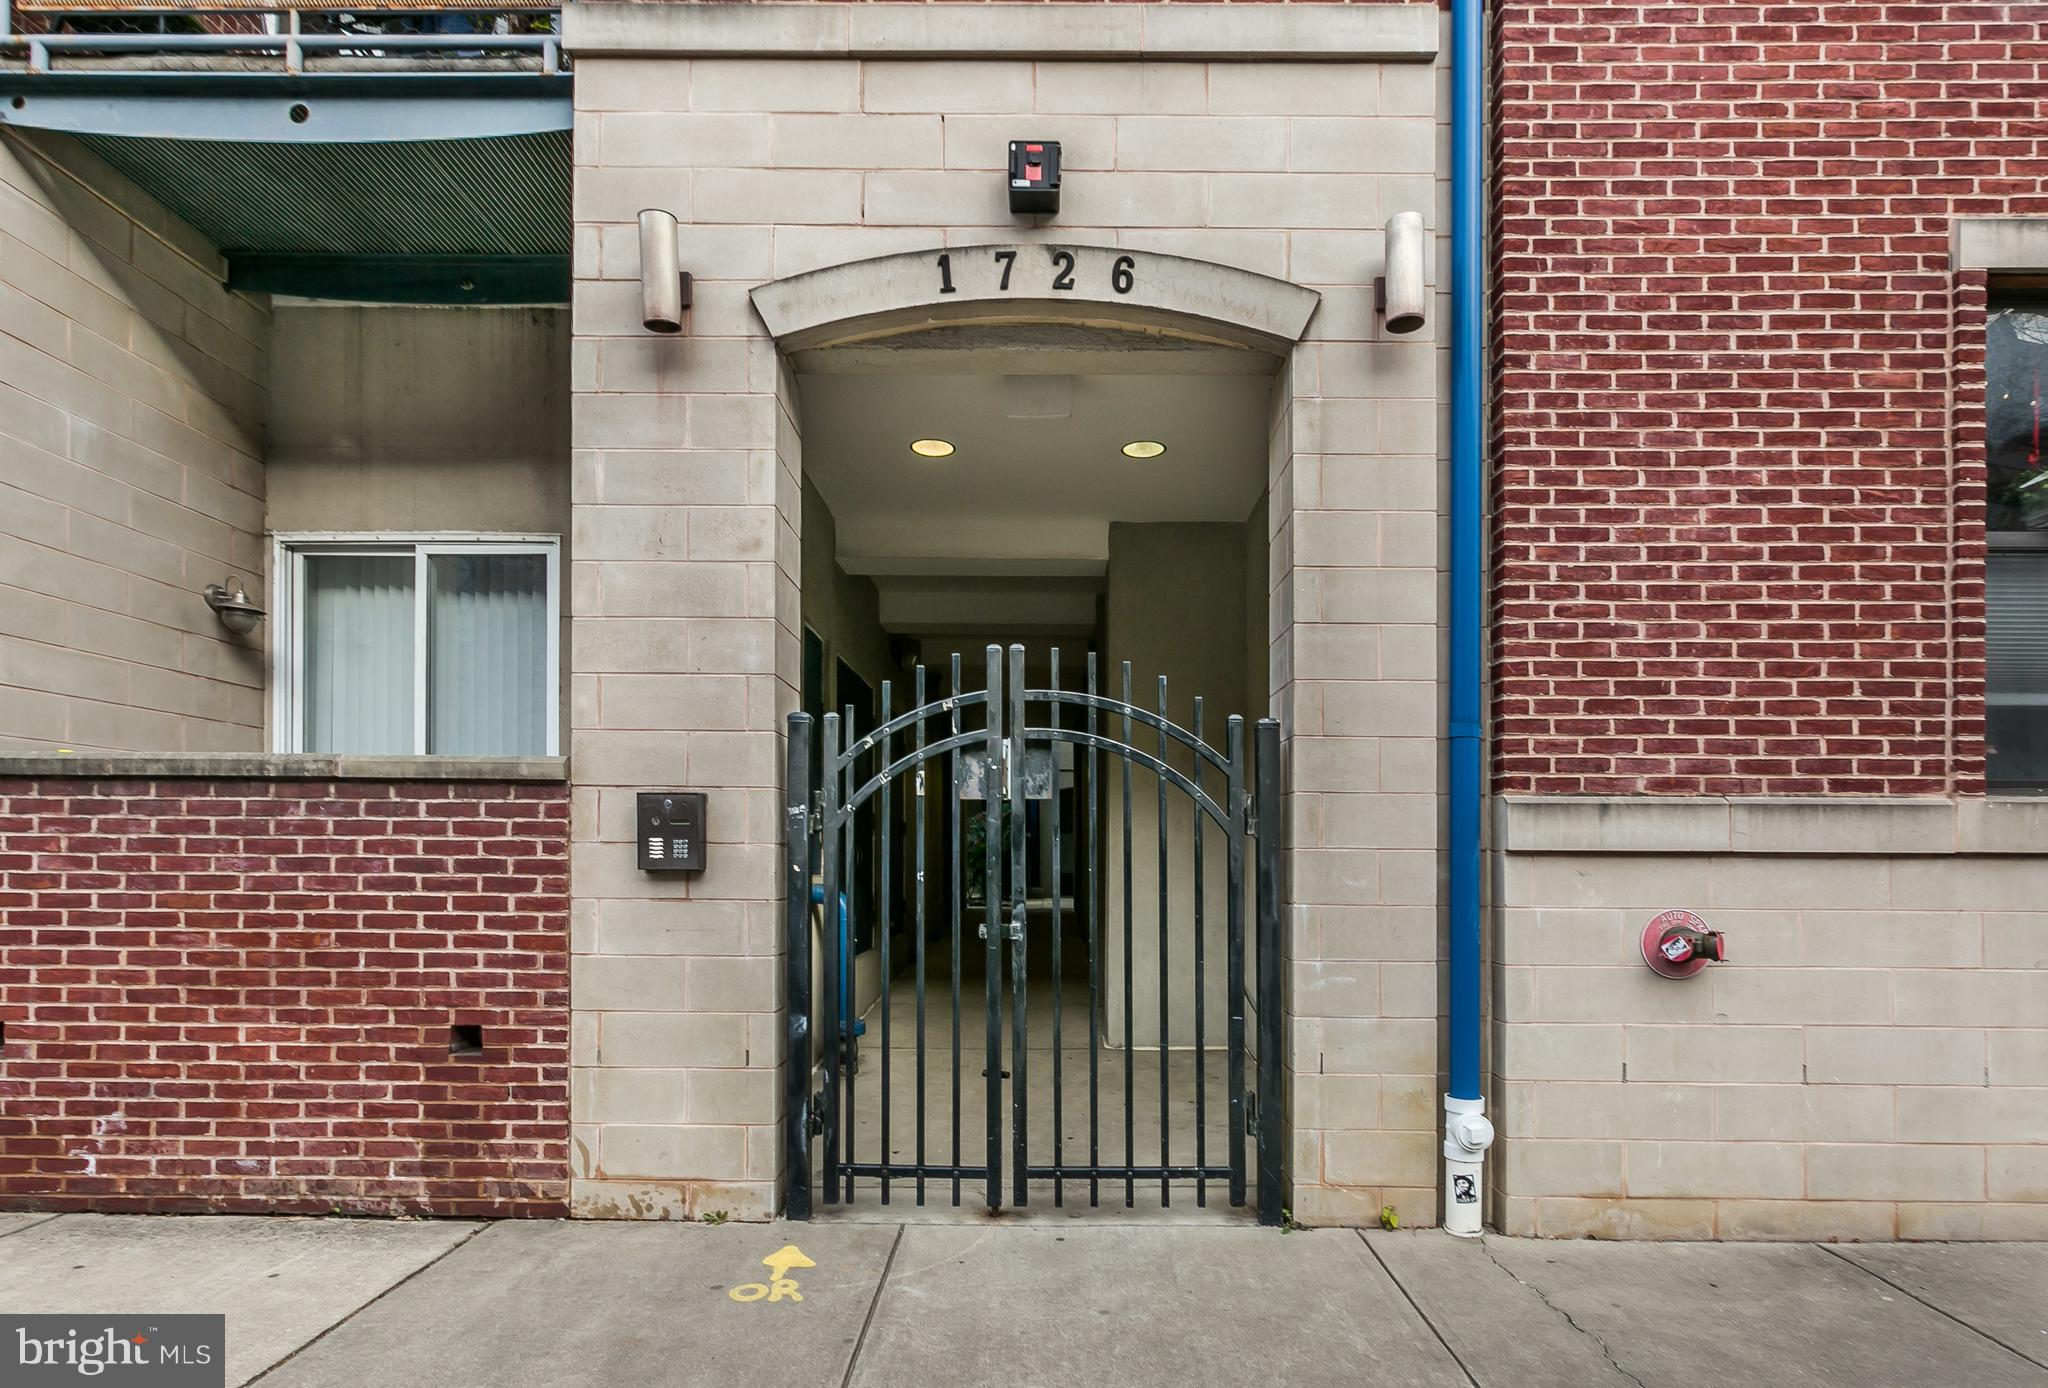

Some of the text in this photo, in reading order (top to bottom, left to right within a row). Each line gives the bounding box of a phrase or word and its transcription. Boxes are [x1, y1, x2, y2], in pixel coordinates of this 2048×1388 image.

[937, 251, 1135, 294] 1726
[1660, 911, 1684, 924] AUTO
[728, 1279, 804, 1303] OR
